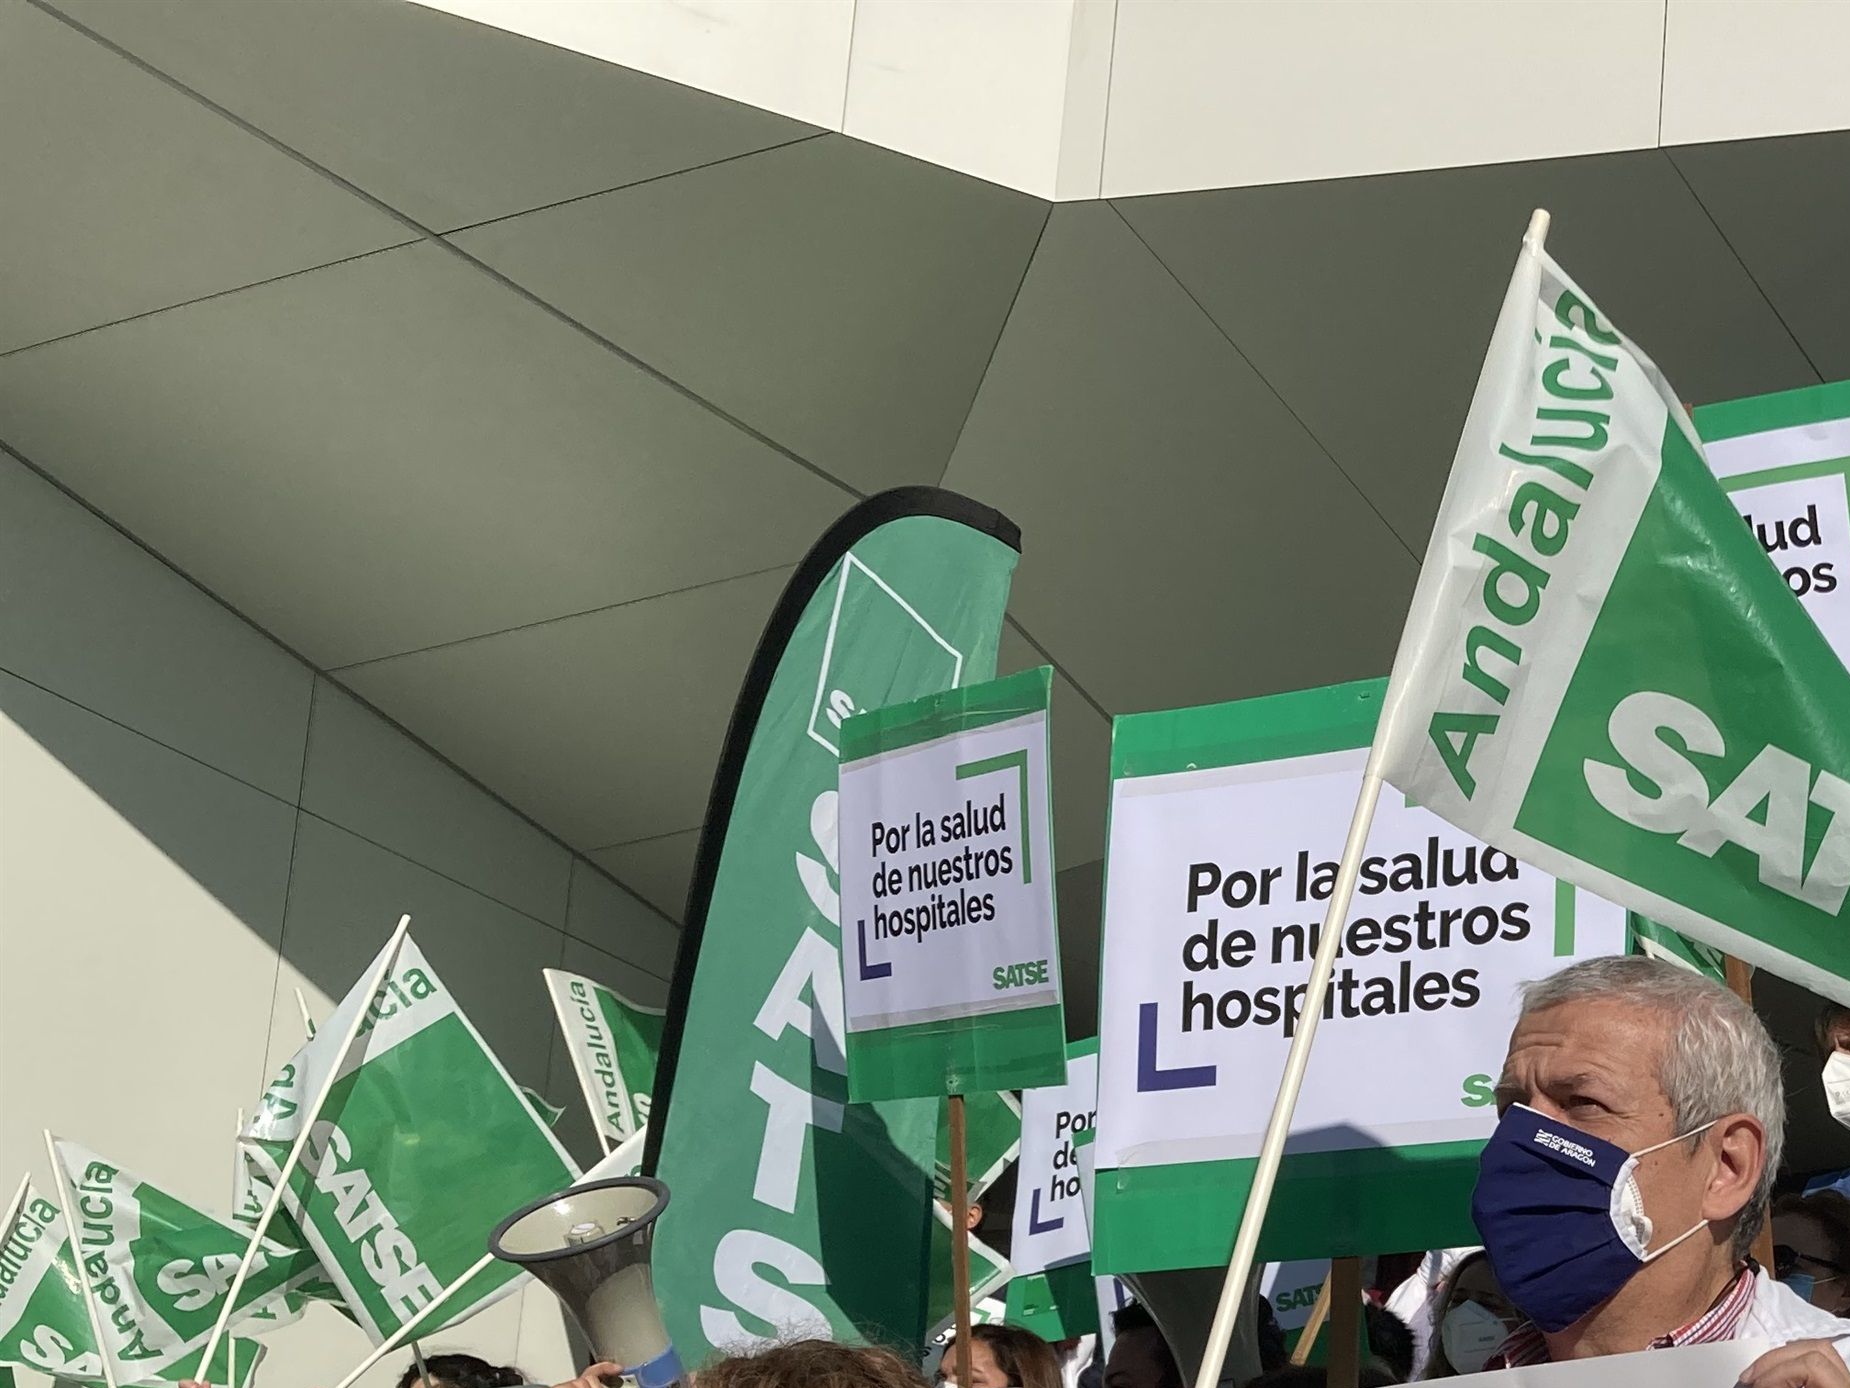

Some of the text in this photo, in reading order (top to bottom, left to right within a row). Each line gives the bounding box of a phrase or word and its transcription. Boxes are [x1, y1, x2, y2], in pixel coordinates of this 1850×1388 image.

[1428, 288, 1626, 802] Andalucía
[871, 791, 1007, 859] Por la salud
[871, 844, 1014, 899] de nuestros
[1186, 836, 1521, 915] Por la salud
[873, 887, 996, 945] hospitales
[1182, 900, 1533, 973] de nuestros
[991, 958, 1050, 991] SATSE
[1180, 961, 1482, 1039] hospitales
[569, 979, 626, 1135] Andalucía
[1054, 1109, 1097, 1139] Por
[1548, 1141, 1561, 1152] DE
[1552, 1135, 1594, 1157] GOBIERNO
[299, 1119, 446, 1328] SATSE
[1275, 1282, 1324, 1314] SAT
